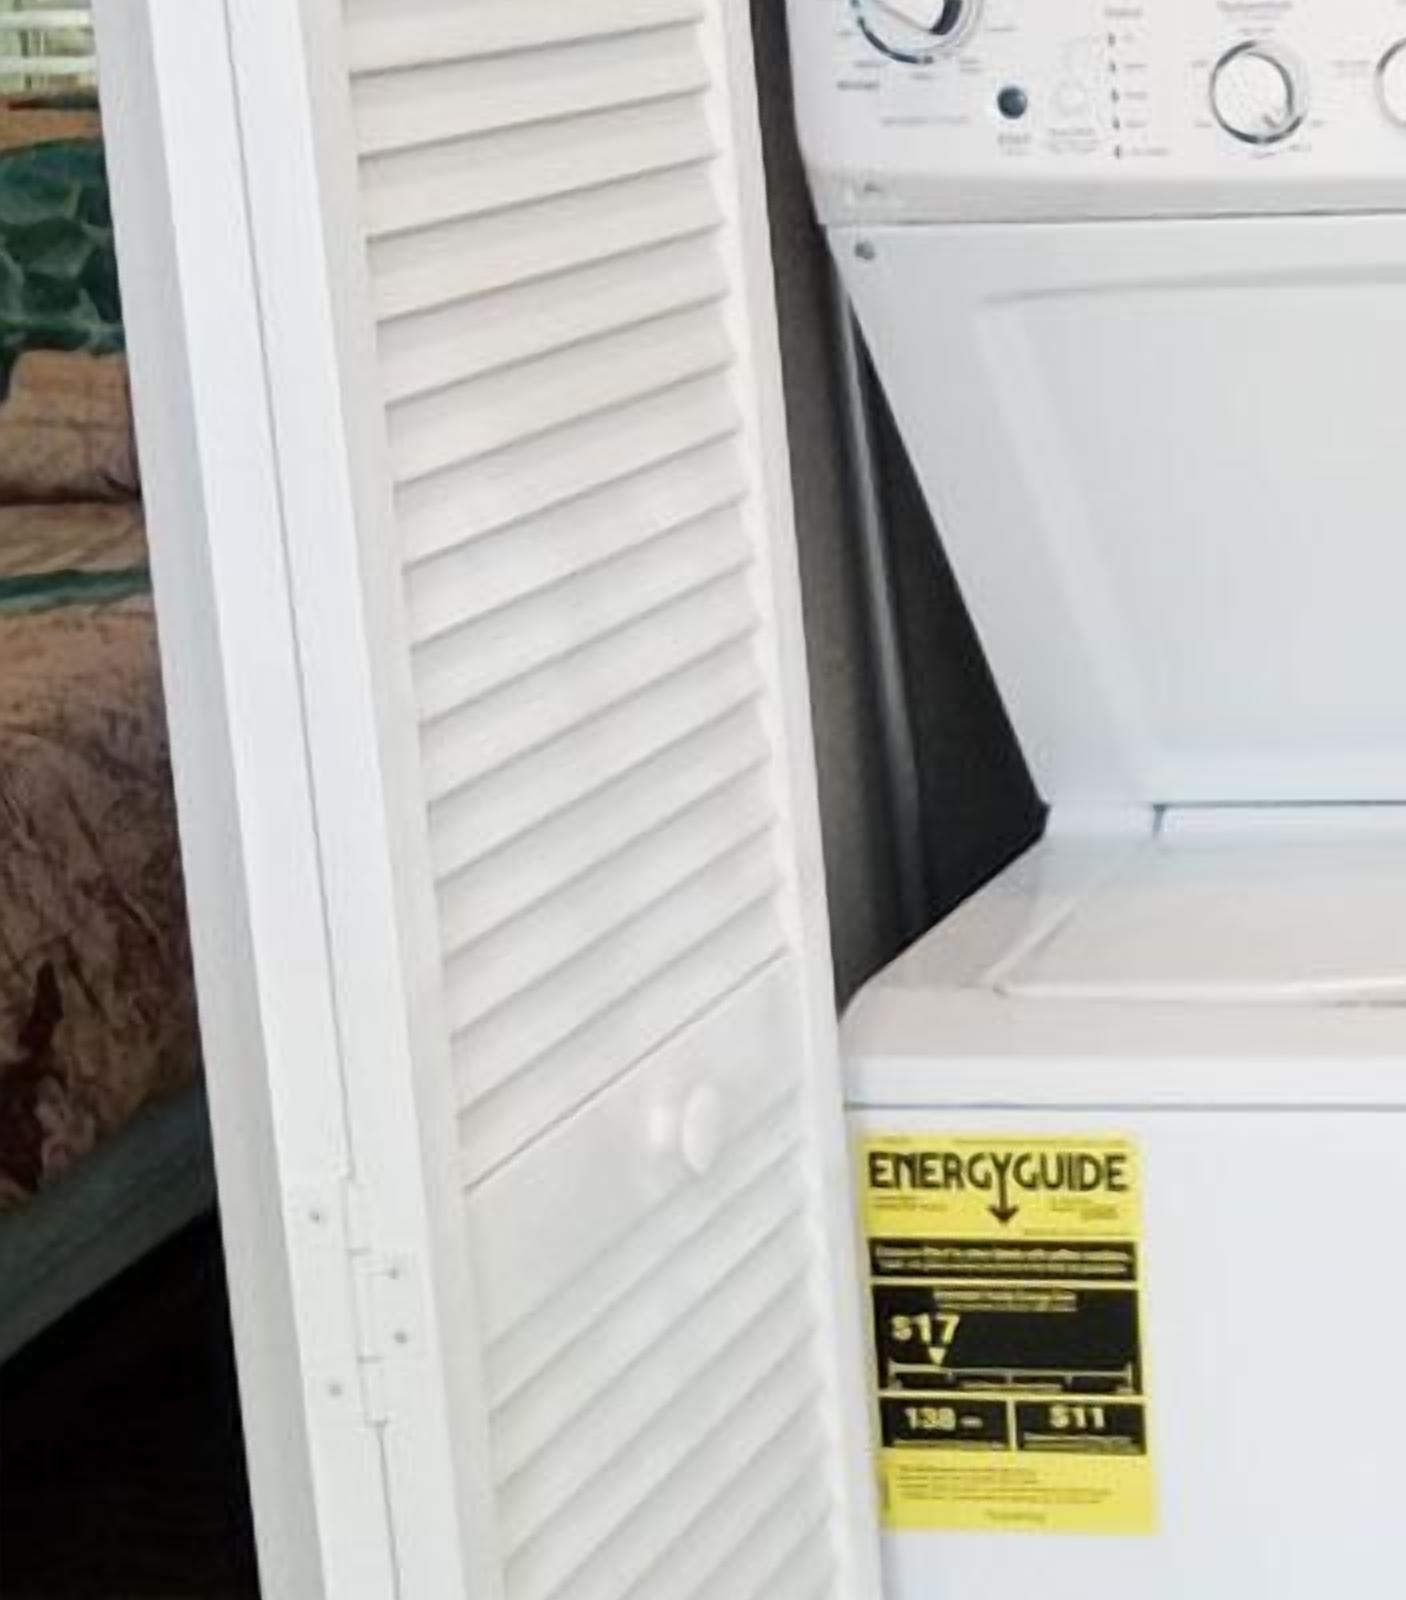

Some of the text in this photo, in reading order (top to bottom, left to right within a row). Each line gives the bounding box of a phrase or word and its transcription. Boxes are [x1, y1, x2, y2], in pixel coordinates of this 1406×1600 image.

[868, 1151, 1130, 1194] ENERGYGUIDE
[890, 1312, 961, 1346] $17
[1048, 1403, 1106, 1430] $11
